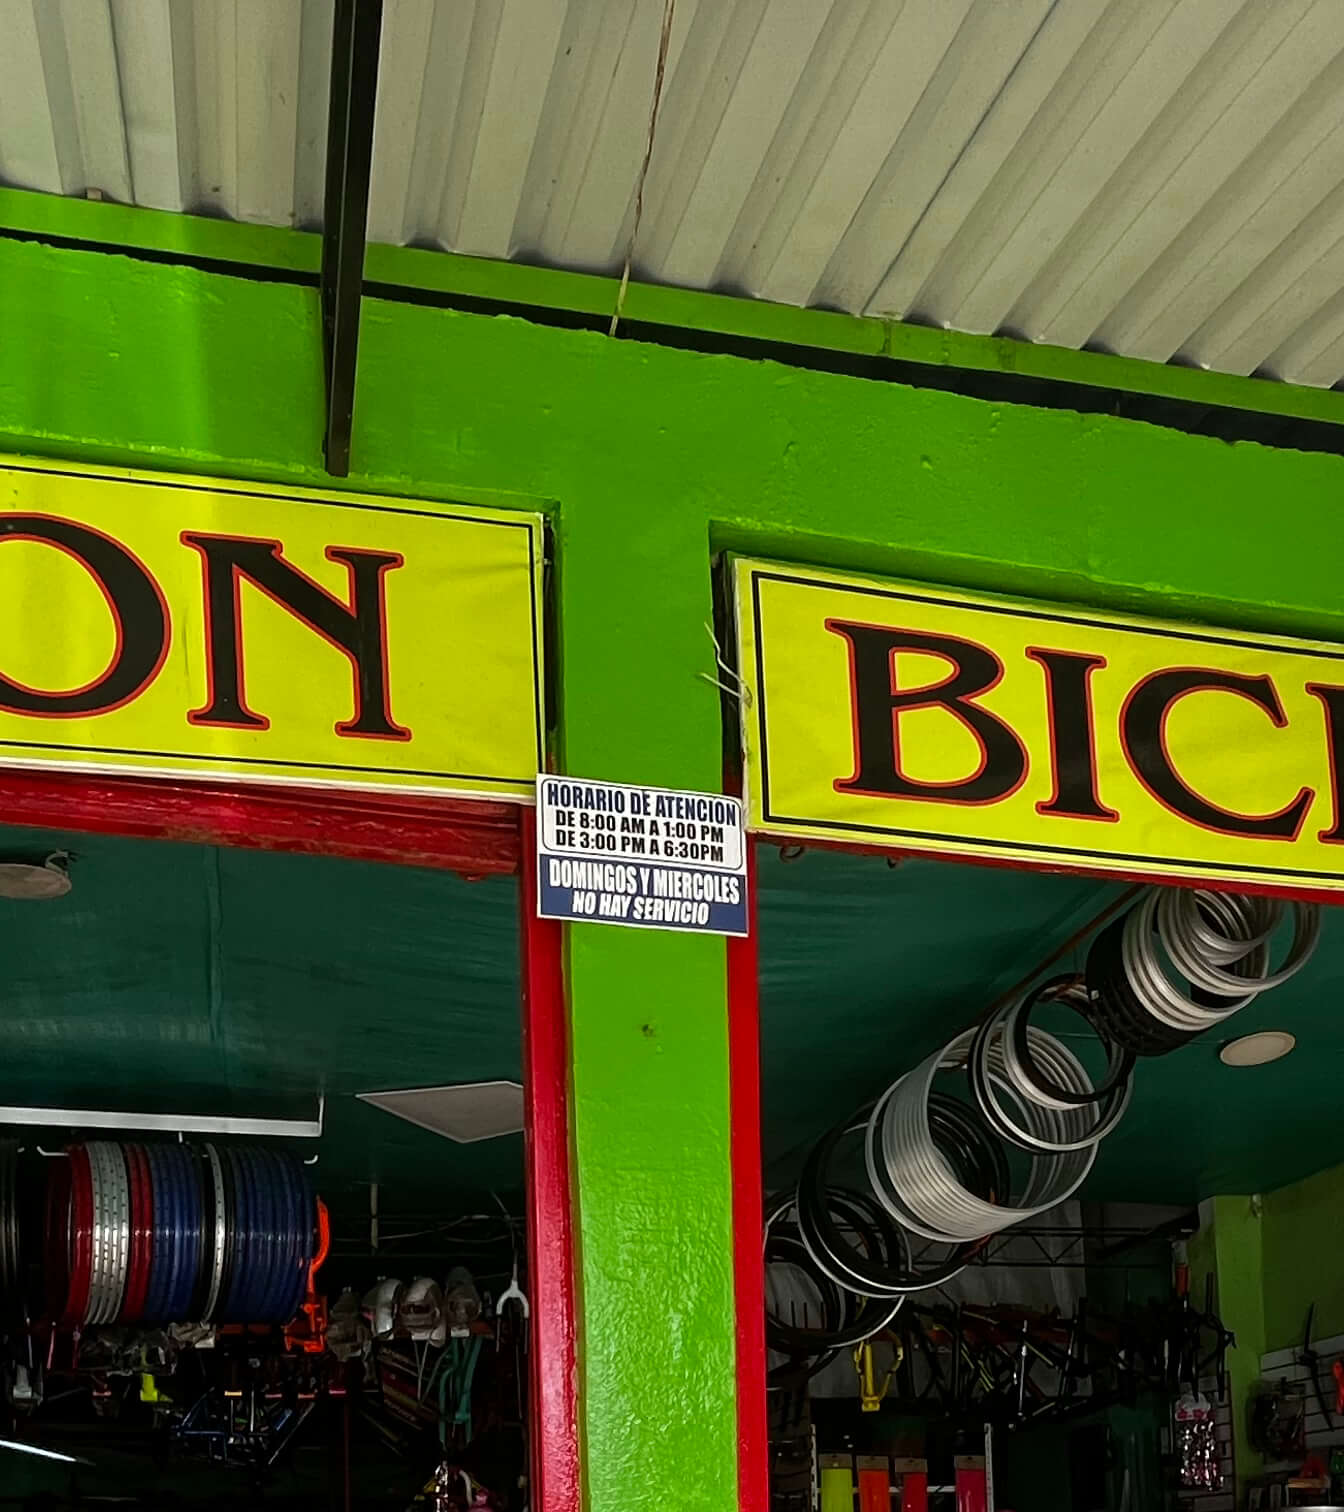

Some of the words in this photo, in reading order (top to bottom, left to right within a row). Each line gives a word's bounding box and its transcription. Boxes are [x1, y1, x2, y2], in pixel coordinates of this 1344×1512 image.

[547, 782, 625, 814] HORARIO
[630, 791, 651, 816] DE
[655, 794, 736, 827] ATENCION
[555, 809, 576, 828] DE
[579, 811, 616, 832] 8:00
[620, 816, 645, 835] AM
[649, 819, 660, 837] A
[663, 821, 696, 840] 1:00
[700, 824, 724, 844] PM
[555, 828, 576, 848] DE
[579, 831, 617, 851] 3:00
[620, 835, 645, 854] PM
[649, 838, 660, 856] A
[663, 840, 724, 863] 6:30PM
[548, 858, 638, 895] DOMINGOS
[638, 866, 651, 896] Y
[652, 868, 741, 905] MIERCOLES
[572, 890, 597, 915] NO
[598, 891, 633, 919] HAY
[632, 896, 710, 925] SERVICIO
